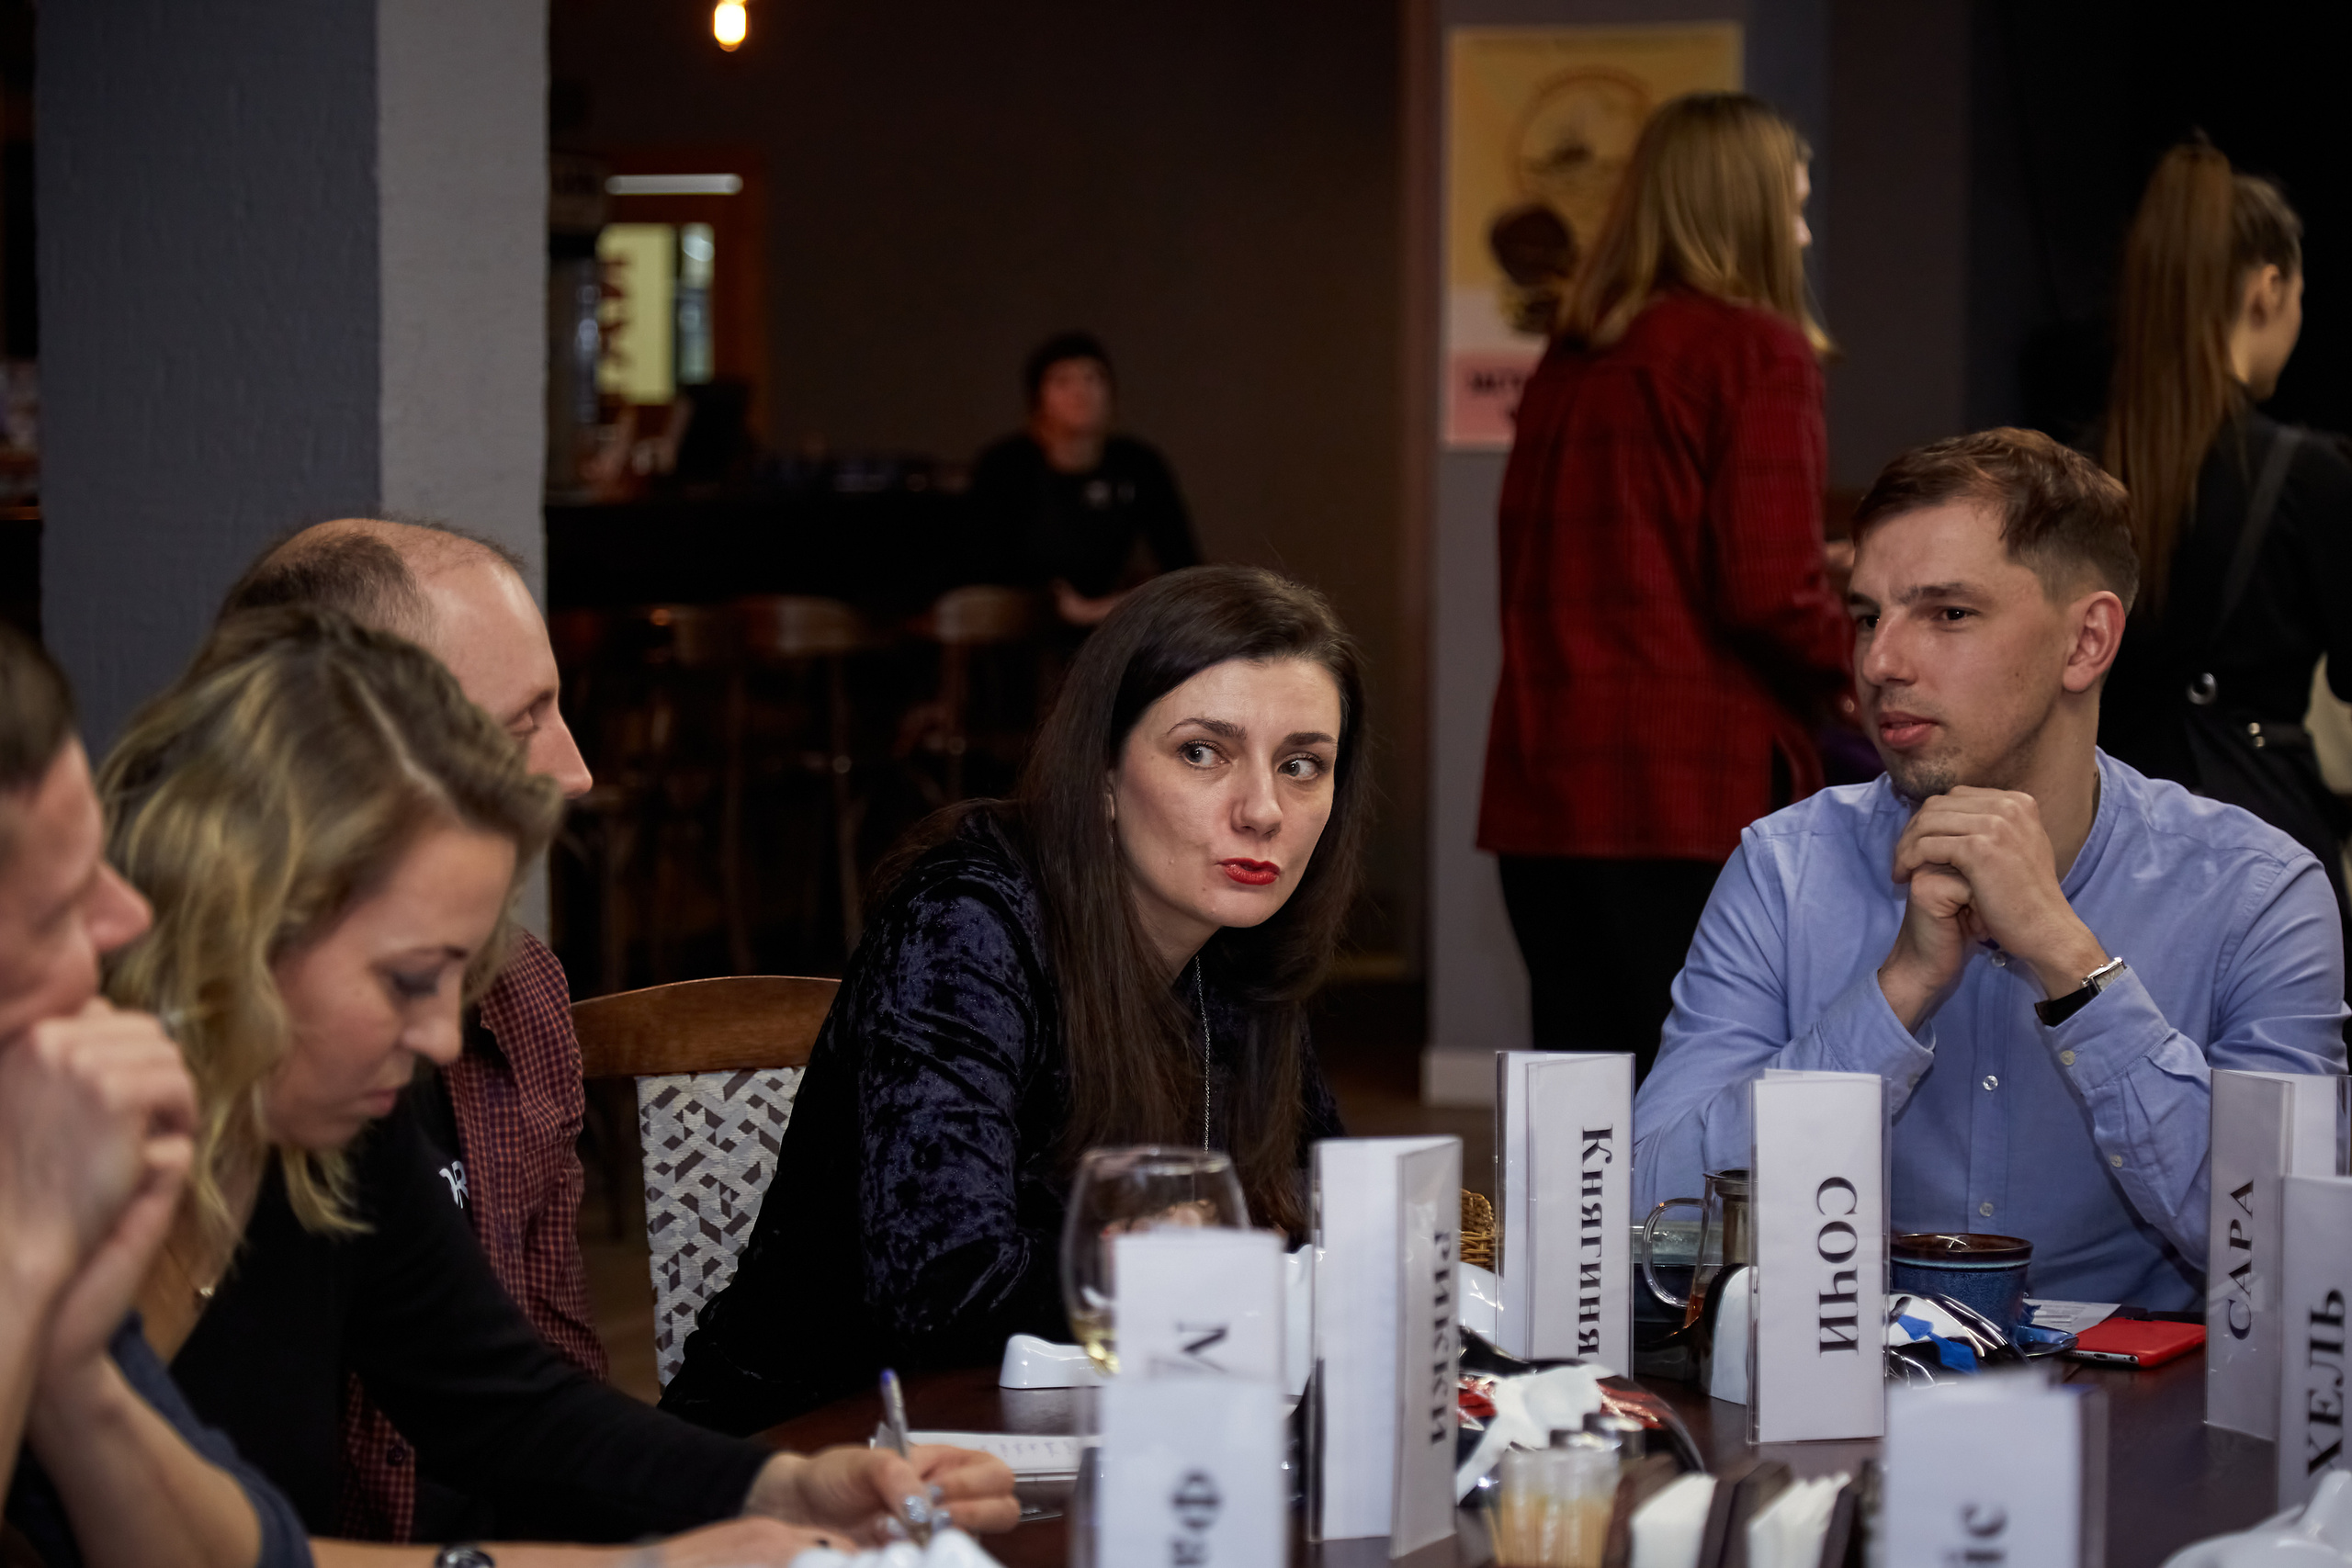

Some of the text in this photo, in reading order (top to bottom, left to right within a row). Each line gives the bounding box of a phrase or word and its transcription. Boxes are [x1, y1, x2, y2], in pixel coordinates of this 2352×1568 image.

[1578, 1123, 1613, 1356] Княгиня
[1816, 1176, 1859, 1356] СОЧИ
[2227, 1179, 2255, 1340] САРА
[2307, 1288, 2347, 1477] ХЕЛЬ
